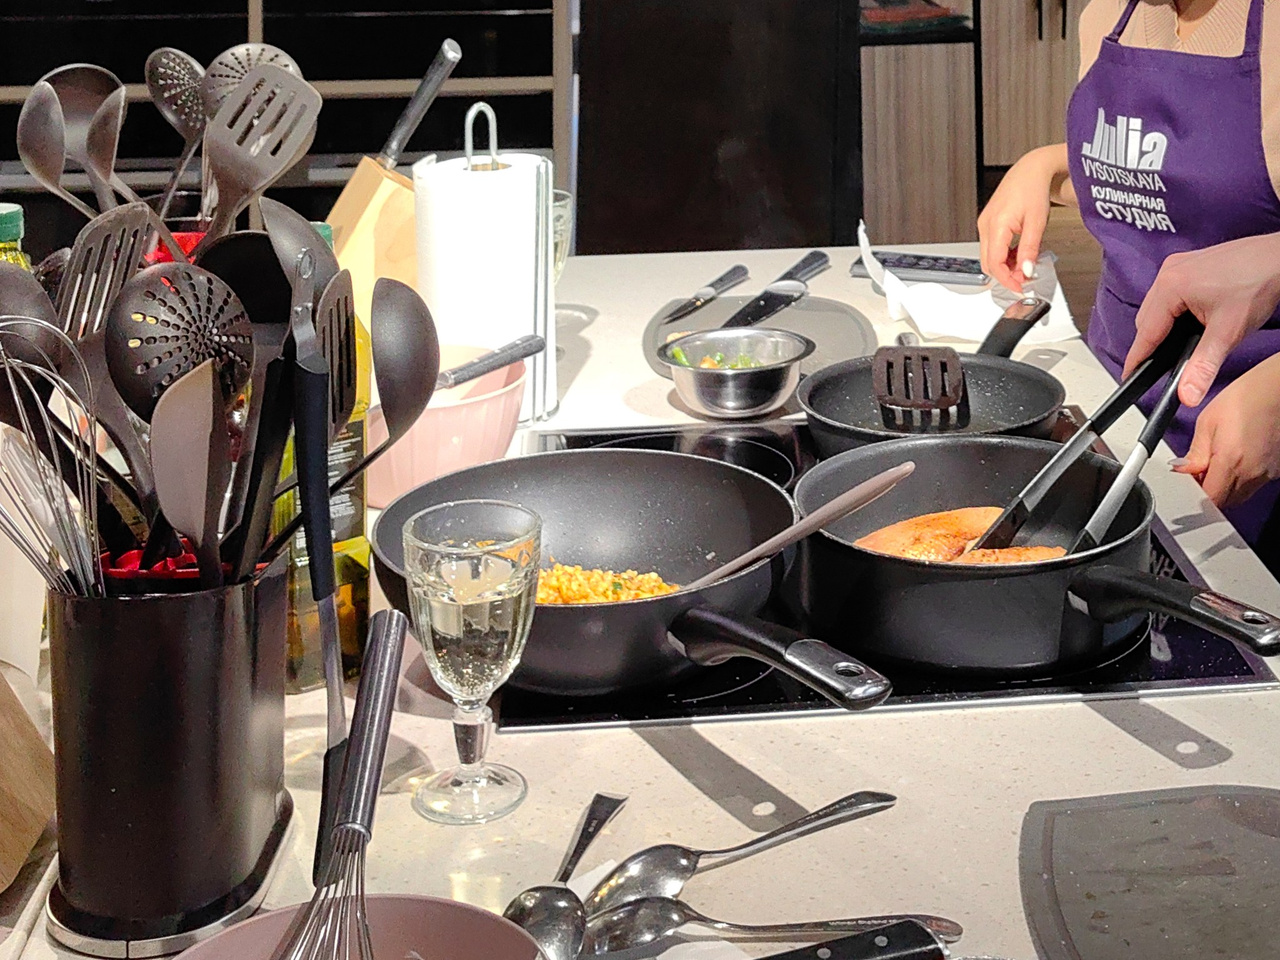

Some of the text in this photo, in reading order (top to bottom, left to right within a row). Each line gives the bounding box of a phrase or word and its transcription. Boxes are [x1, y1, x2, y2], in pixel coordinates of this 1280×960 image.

[1081, 107, 1168, 171] Julia
[1081, 157, 1167, 193] VYSOTSKAYA
[1090, 184, 1167, 213] КУЛИНАРНАЯ
[1095, 200, 1176, 234] СТУДИЯ
